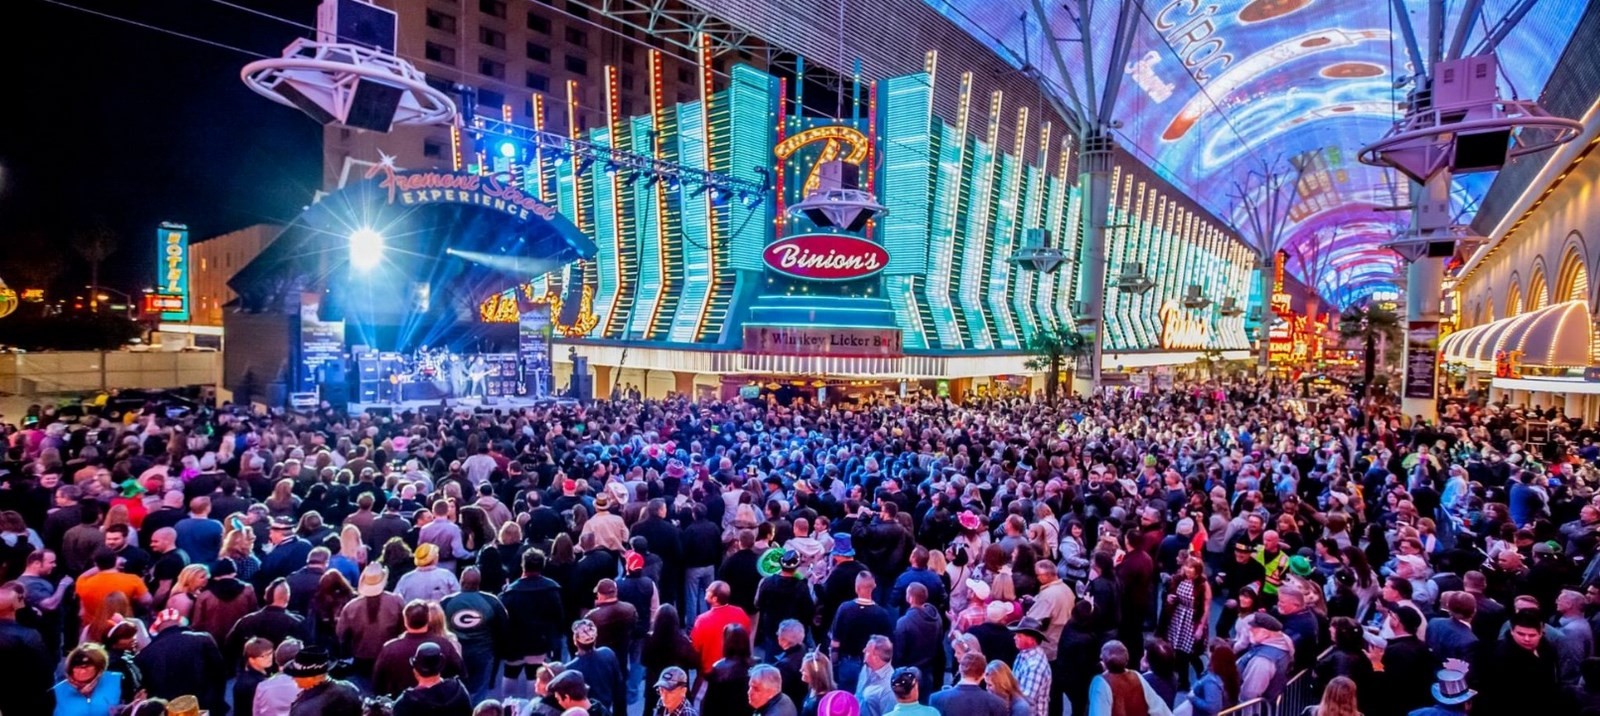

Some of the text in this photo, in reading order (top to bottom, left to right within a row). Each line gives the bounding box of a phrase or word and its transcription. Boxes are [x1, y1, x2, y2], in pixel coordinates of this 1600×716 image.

[364, 161, 556, 221] Fremont Street
[402, 189, 529, 220] EXPERIENCE
[166, 232, 182, 292] HOTEL
[772, 243, 880, 269] Binion's
[830, 333, 870, 347] Licker
[873, 335, 892, 348] Bar
[453, 610, 481, 628] G
